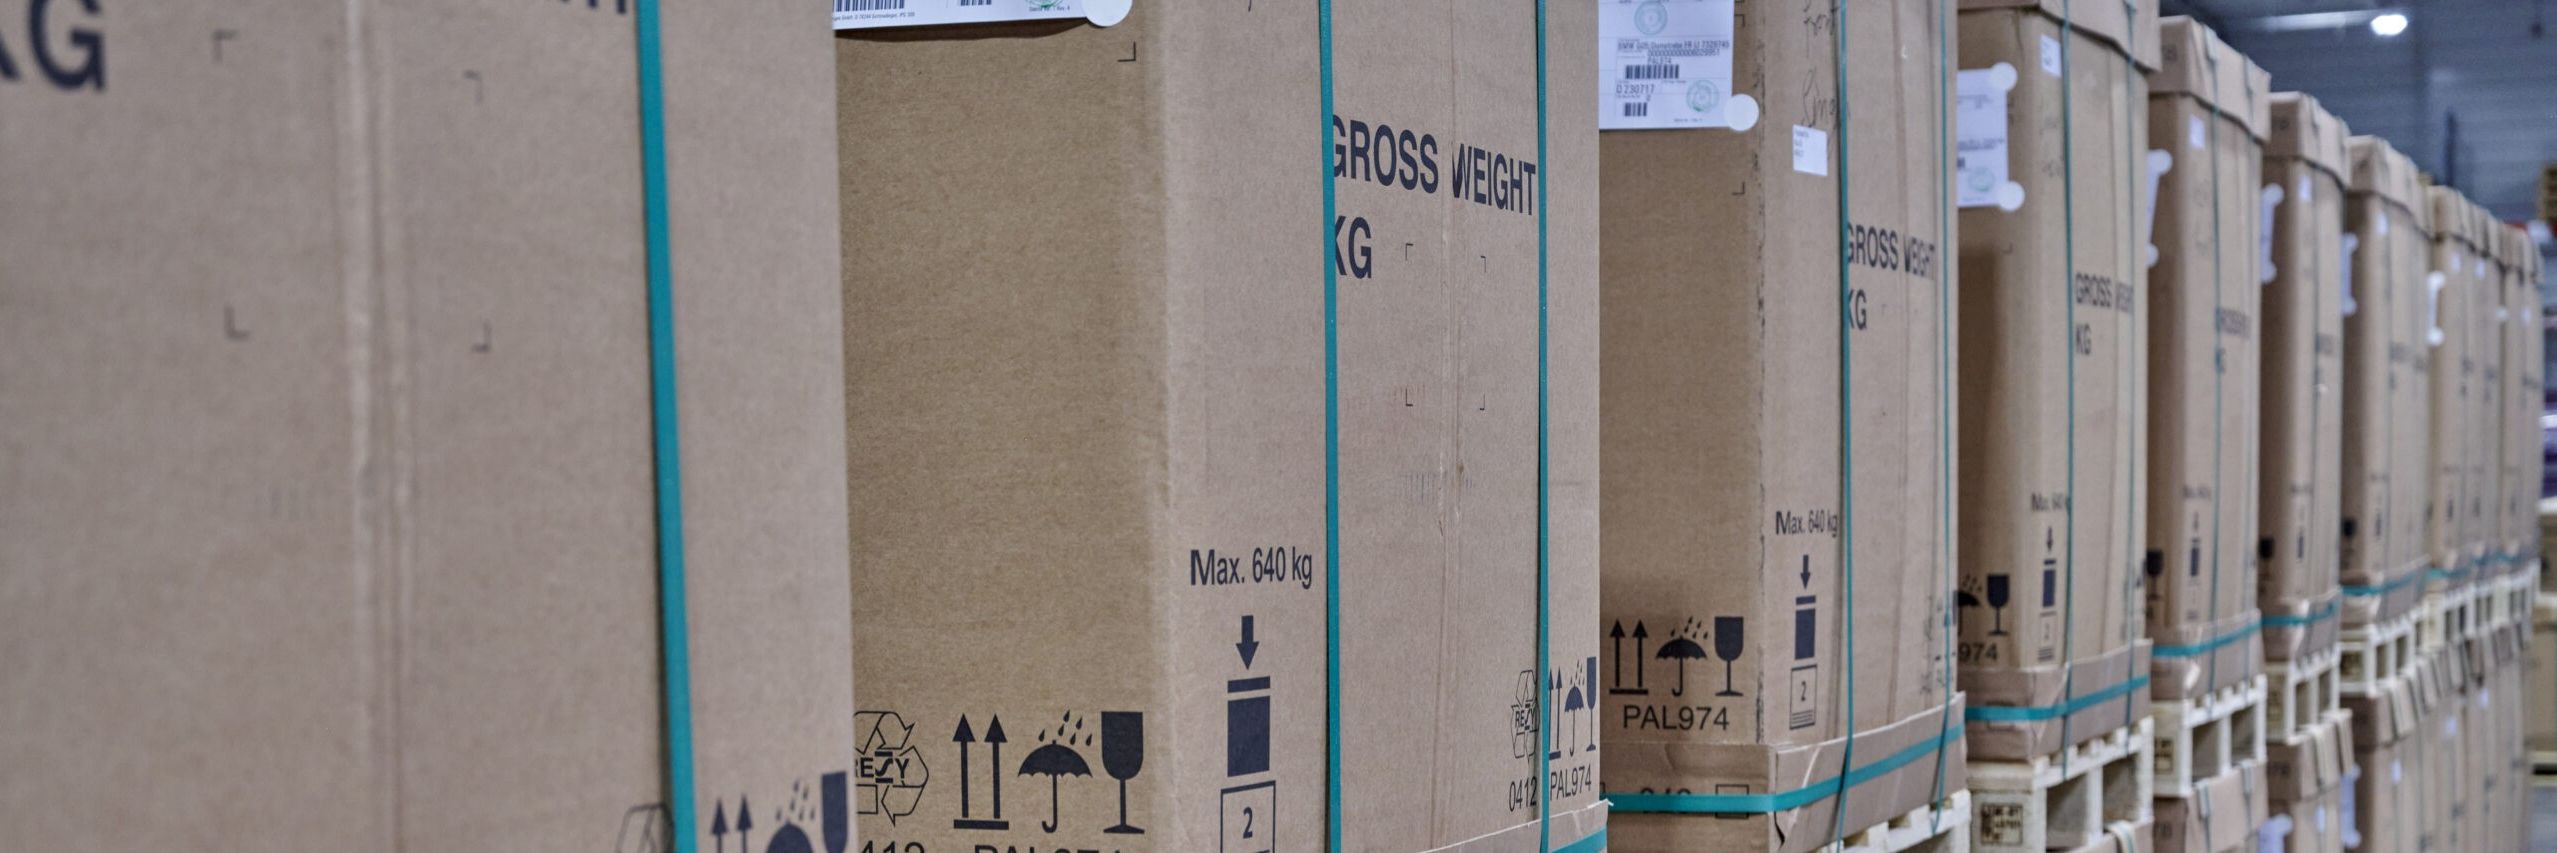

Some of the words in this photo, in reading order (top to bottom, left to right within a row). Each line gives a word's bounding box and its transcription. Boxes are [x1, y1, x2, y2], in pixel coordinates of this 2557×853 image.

[1333, 114, 1438, 194] GROSS
[1452, 143, 1536, 215] WEIGHT
[1848, 221, 1899, 271] GROSS
[1808, 509, 1825, 534] 640
[1190, 549, 1245, 586] Max.
[1253, 546, 1286, 583] 640
[1292, 546, 1312, 590] kg
[1623, 705, 1730, 731] PAL974
[1509, 776, 1538, 812] 0412
[1550, 763, 1592, 801] PAL974
[1243, 806, 1253, 839] 2
